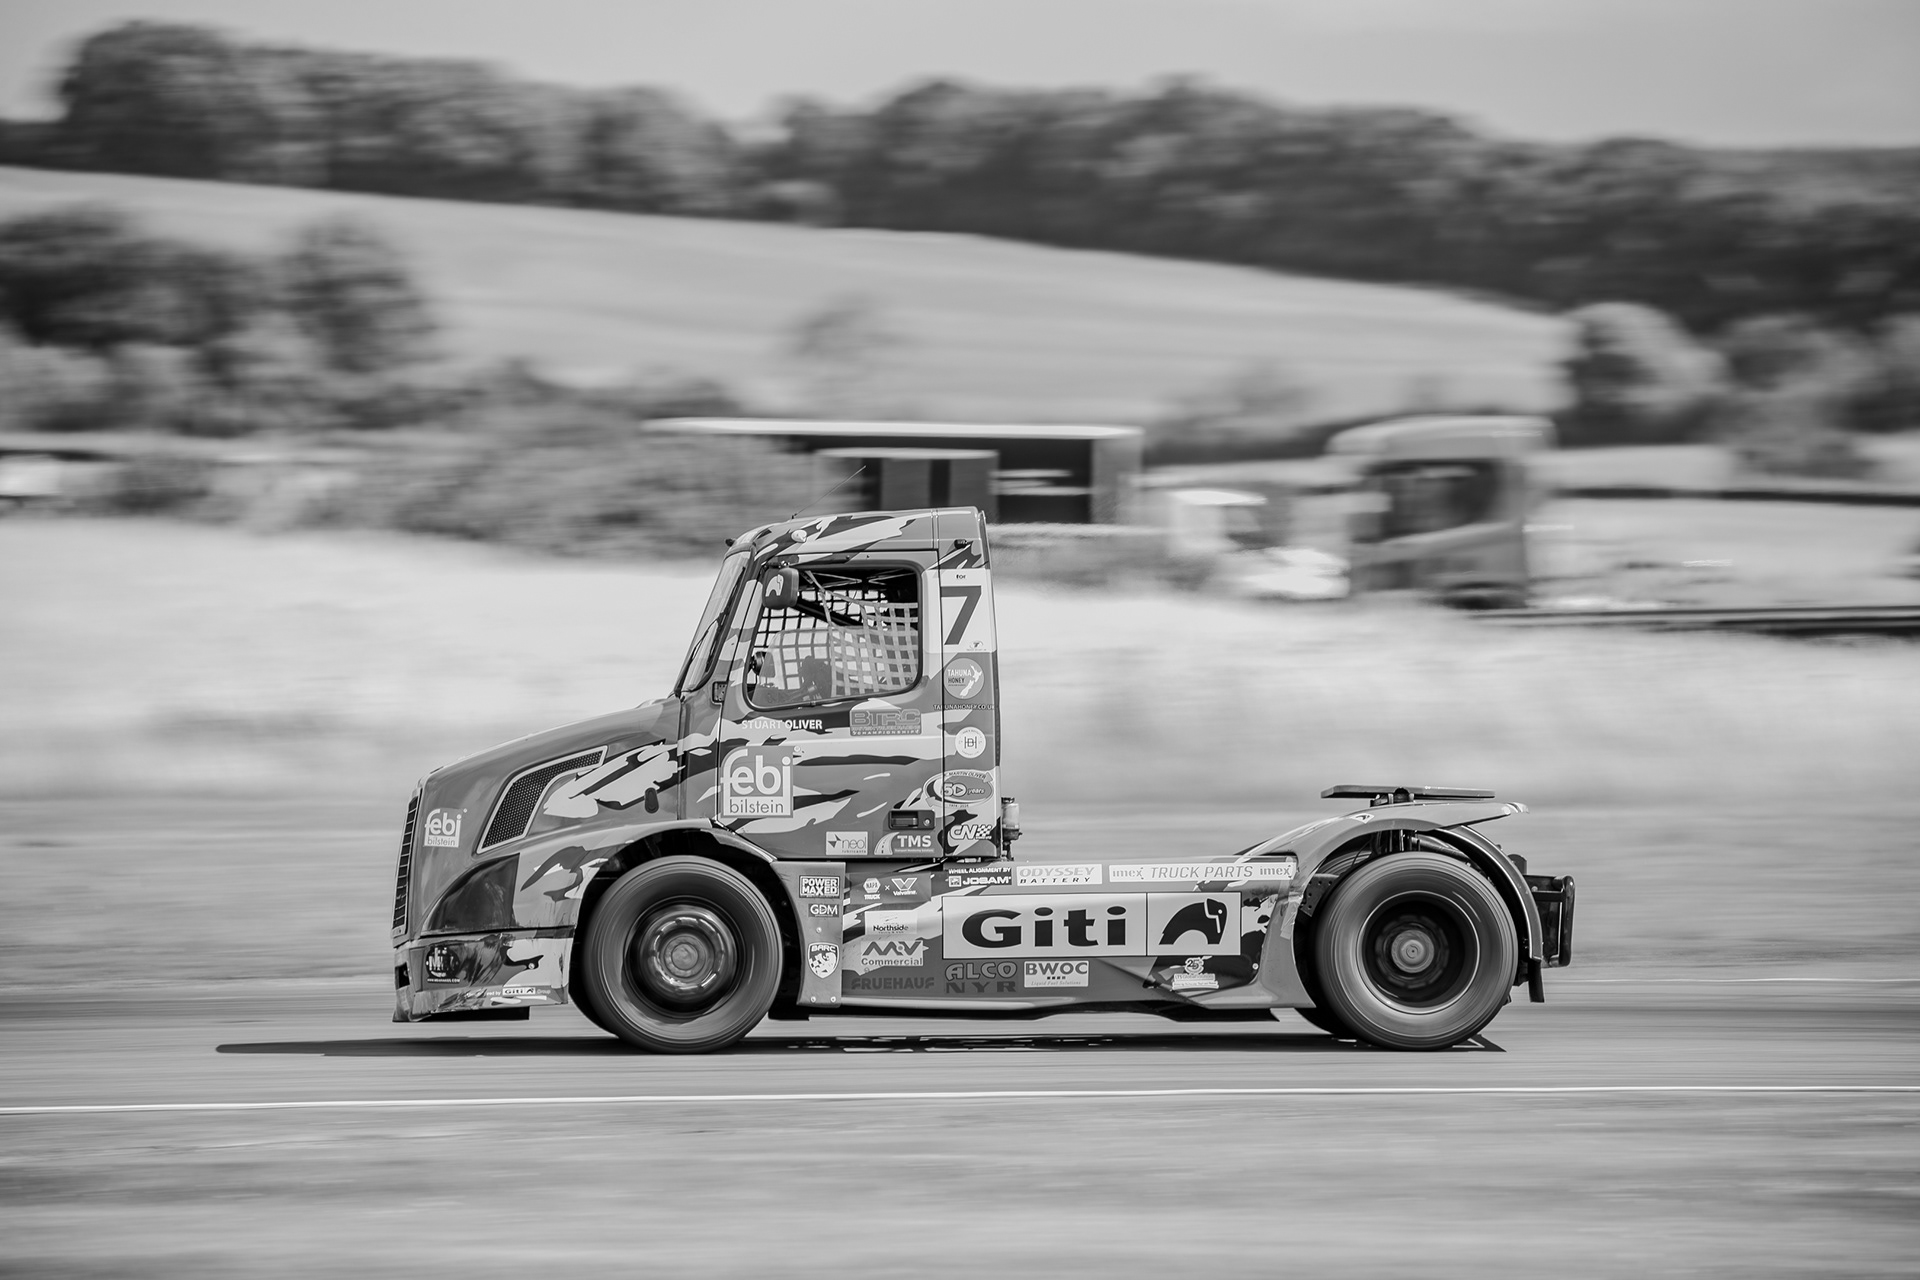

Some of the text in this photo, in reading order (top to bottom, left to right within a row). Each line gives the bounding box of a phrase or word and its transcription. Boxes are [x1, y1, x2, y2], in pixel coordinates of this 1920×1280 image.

[940, 585, 982, 645] 7
[850, 708, 921, 726] BTRC
[742, 719, 823, 730] STUART OLIVER
[720, 748, 791, 796] febi
[969, 771, 987, 780] OLIVER
[967, 788, 986, 796] years
[729, 798, 784, 814] bilstein
[425, 808, 462, 836] febi
[427, 837, 456, 846] bilstein
[842, 837, 867, 849] neol
[897, 835, 932, 848] TMS
[1019, 866, 1095, 877] ODYSSEY
[1112, 864, 1292, 879] imex TRUCK PARTS imex
[802, 878, 838, 887] POWER
[962, 875, 1009, 886] JOSAM
[802, 885, 838, 896] MAXED
[810, 904, 838, 915] GDM
[873, 924, 909, 932] Northside
[961, 906, 1127, 949] Giti
[811, 944, 836, 952] BARC
[861, 957, 923, 967] Commercial
[945, 961, 1018, 982] ALCO
[1025, 963, 1088, 976] BWOC
[851, 976, 935, 990] FRUEHAUF
[946, 981, 1017, 994] NYR
